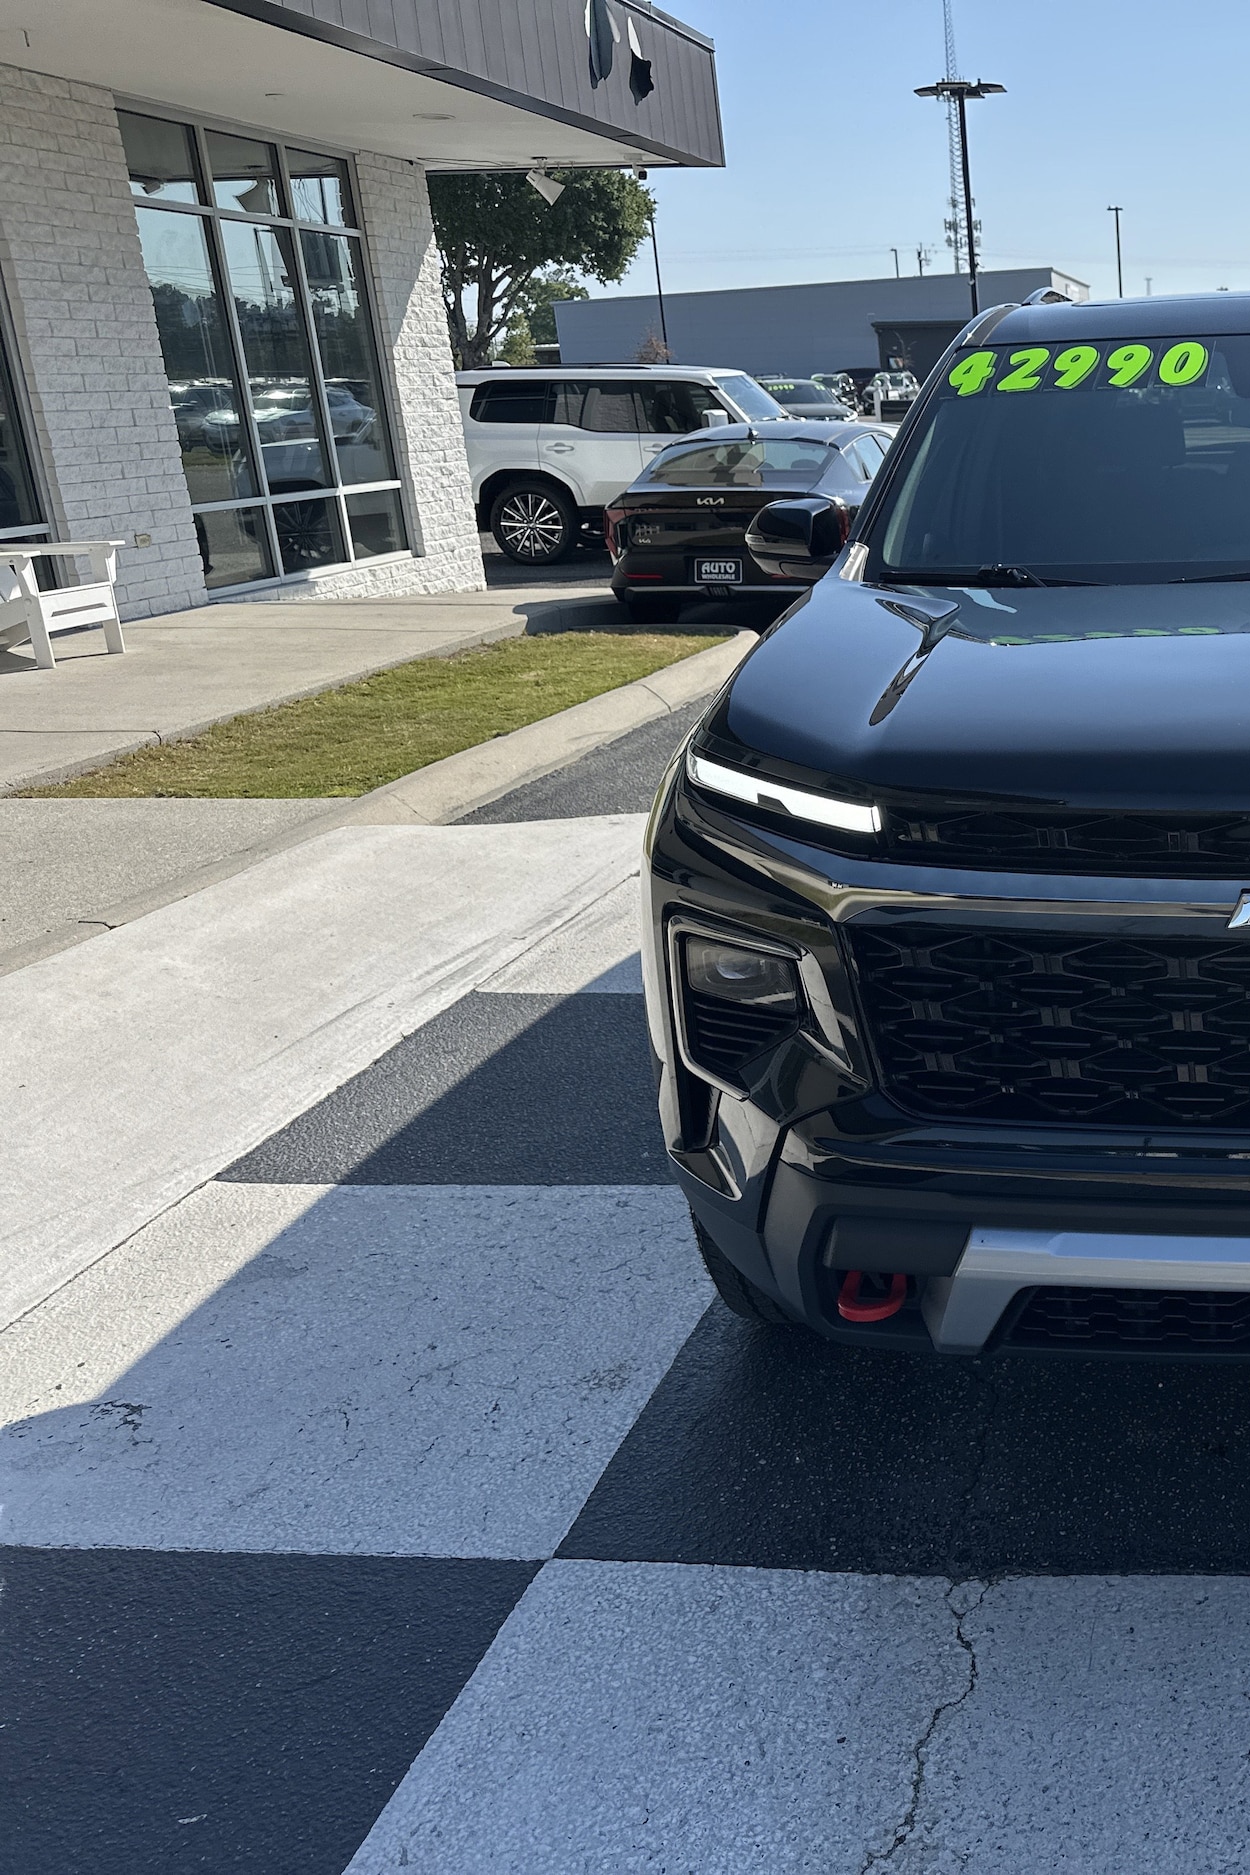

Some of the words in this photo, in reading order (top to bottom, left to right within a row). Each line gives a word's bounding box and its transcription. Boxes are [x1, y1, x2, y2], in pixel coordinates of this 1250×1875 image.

[948, 342, 1209, 397] 42990
[697, 497, 725, 506] KIA
[701, 562, 736, 574] AUTO
[701, 573, 736, 581] WHOLESALE
